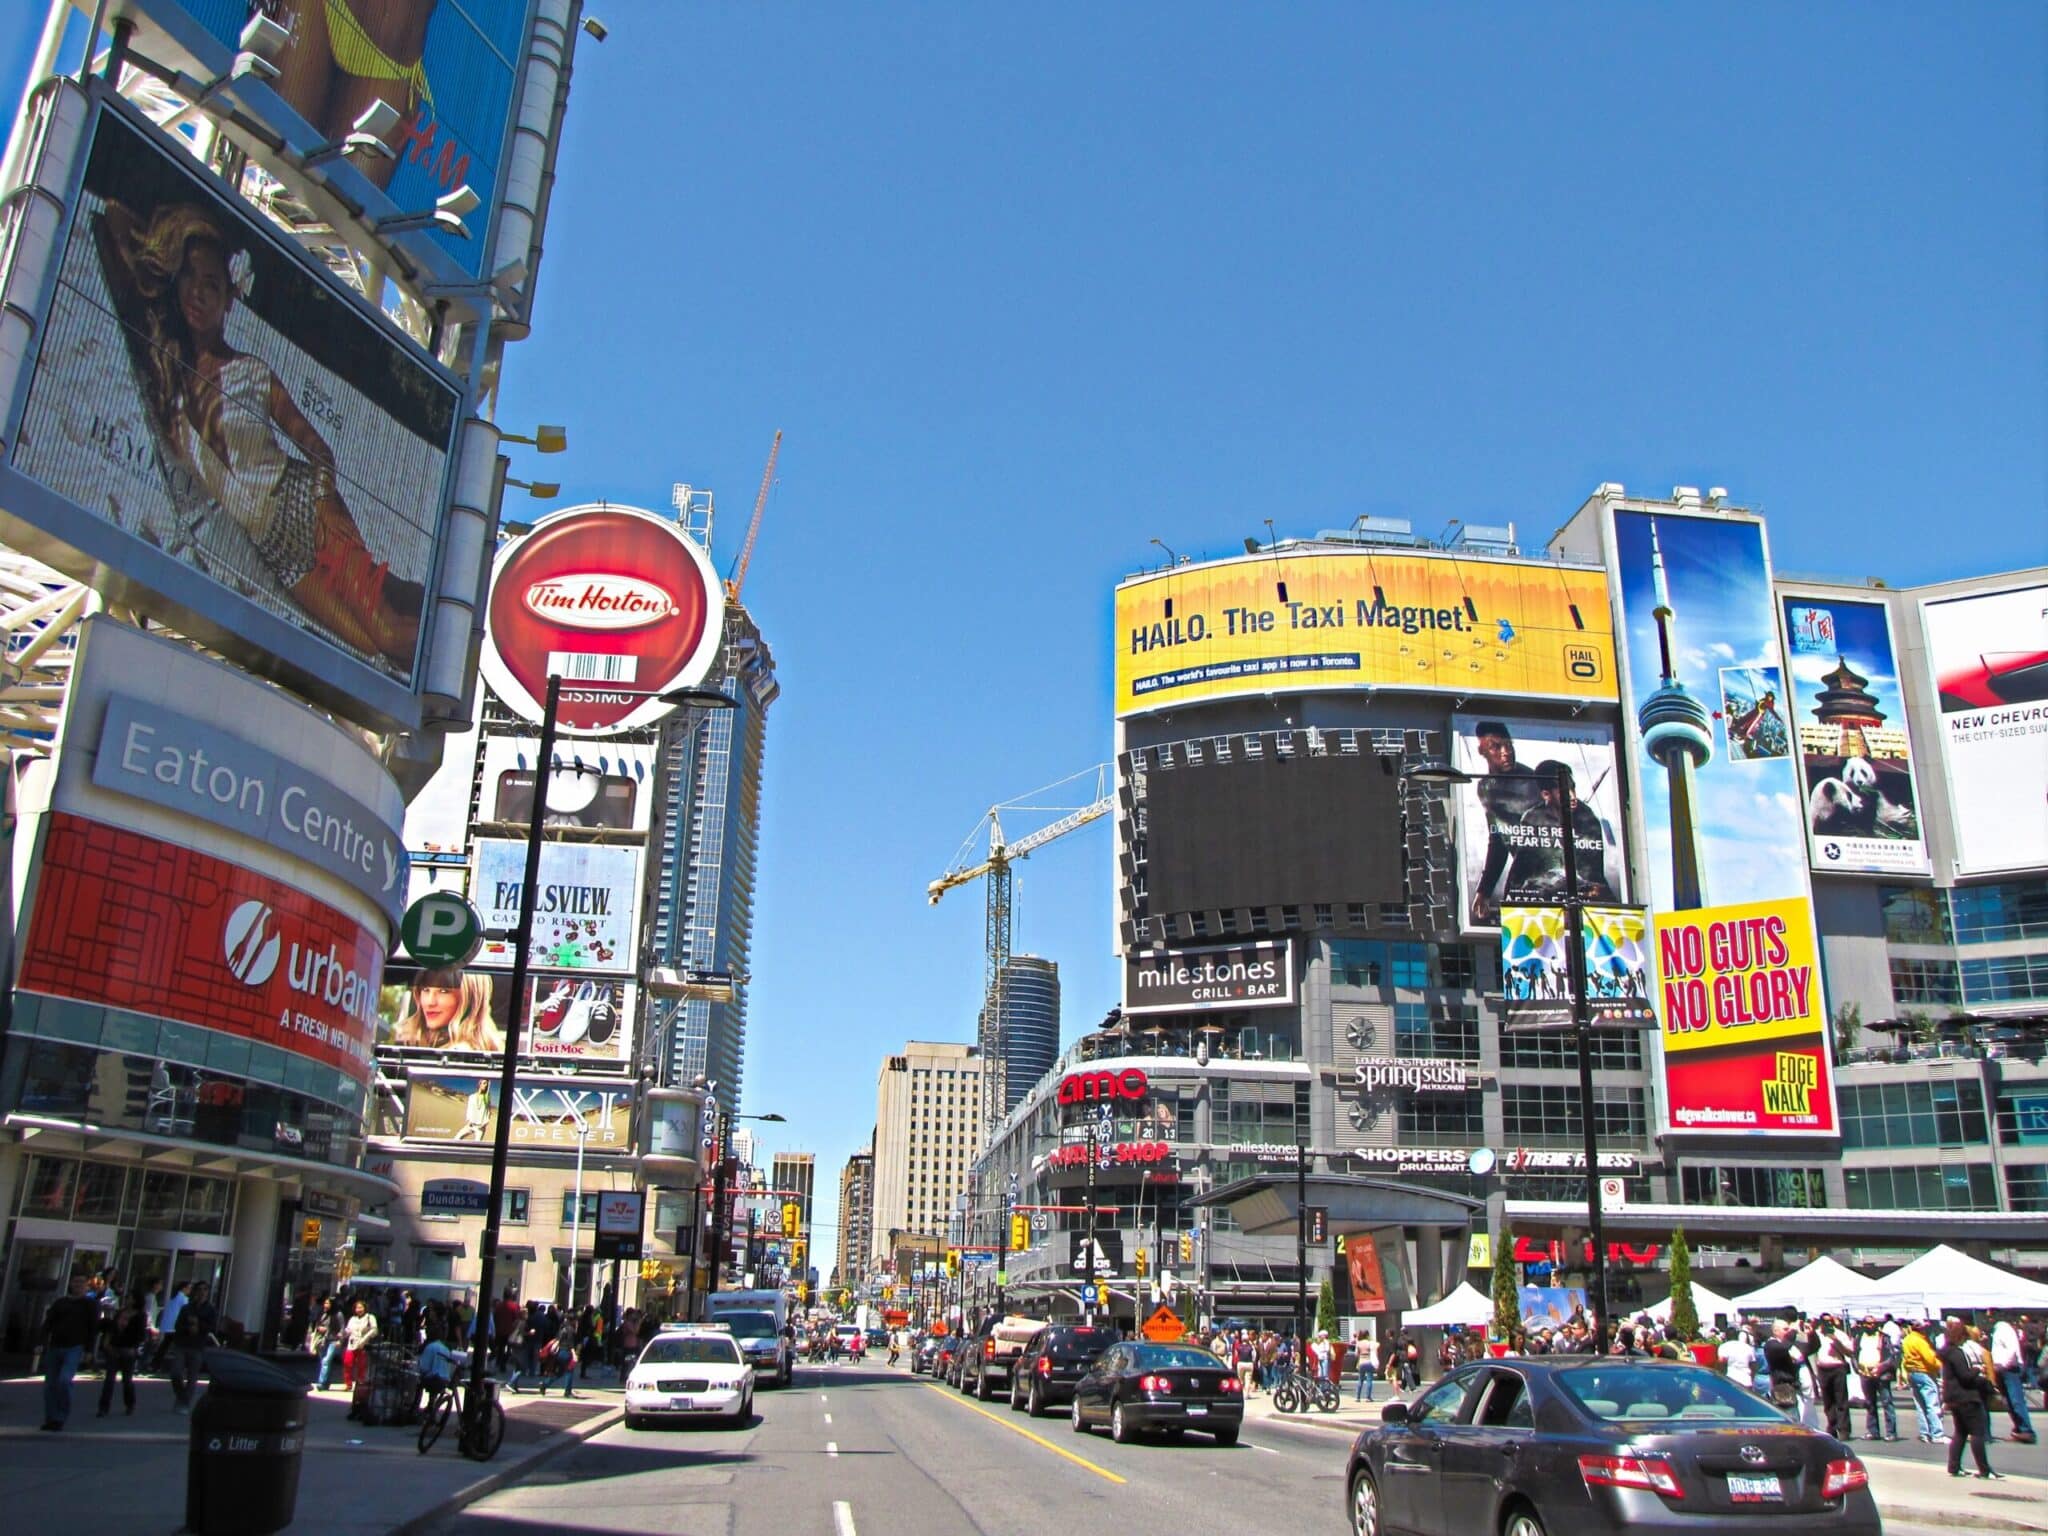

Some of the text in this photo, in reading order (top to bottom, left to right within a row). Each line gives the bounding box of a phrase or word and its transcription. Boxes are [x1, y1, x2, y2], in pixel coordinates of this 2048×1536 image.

[530, 584, 674, 615] Tim Hortons
[1132, 599, 1473, 655] HAILO. The Taxi Magnet.
[1570, 650, 1594, 661] HAIL
[1161, 676, 1176, 686] The
[1177, 669, 1204, 683] world's
[1206, 666, 1242, 678] favourite
[1243, 663, 1260, 672] taxi
[1262, 661, 1278, 671] app
[1279, 659, 1288, 669] is
[1290, 658, 1308, 668] now
[1310, 657, 1319, 667] in
[1321, 655, 1356, 667] Toronto.
[1952, 715, 1986, 731] NEW
[1953, 733, 1971, 744] THE
[1973, 726, 2027, 742] CITY-SIZED
[121, 721, 376, 873] Eaton Centre
[1490, 824, 1580, 839] DANGER IS REL
[1510, 836, 1603, 850] FEAR IS A HOICE
[494, 881, 609, 916] FALSVIEW
[416, 900, 468, 948] P
[492, 912, 545, 926] CASO
[1660, 915, 1788, 978] NO GUTS
[1138, 961, 1276, 988] milestones
[1191, 986, 1232, 1000] GRILL
[1247, 984, 1275, 996] BAR
[1664, 965, 1811, 1033] NO GLORY
[280, 1008, 290, 1029] A
[294, 1012, 329, 1042] FRESH
[1355, 1059, 1466, 1093] spring sushi
[1779, 1054, 1815, 1087] EDGE
[1764, 1083, 1807, 1112] WALK
[702, 1080, 718, 1148] Yonge
[515, 1127, 617, 1143] OREVER
[1100, 1103, 1113, 1171] Yonge
[1143, 1127, 1154, 1138] 20
[1164, 1129, 1175, 1139] 13
[1116, 1142, 1169, 1162] SHOP
[1231, 1141, 1299, 1154] milestones
[1354, 1148, 1466, 1163] SHOPPERS
[1257, 1154, 1277, 1162] GRILL
[1400, 1162, 1467, 1172] DRUG MART
[1505, 1147, 1573, 1172] EXTREME
[1776, 1169, 1821, 1190] NOW
[428, 1192, 466, 1206] Dundas
[228, 1436, 260, 1450] Litter
